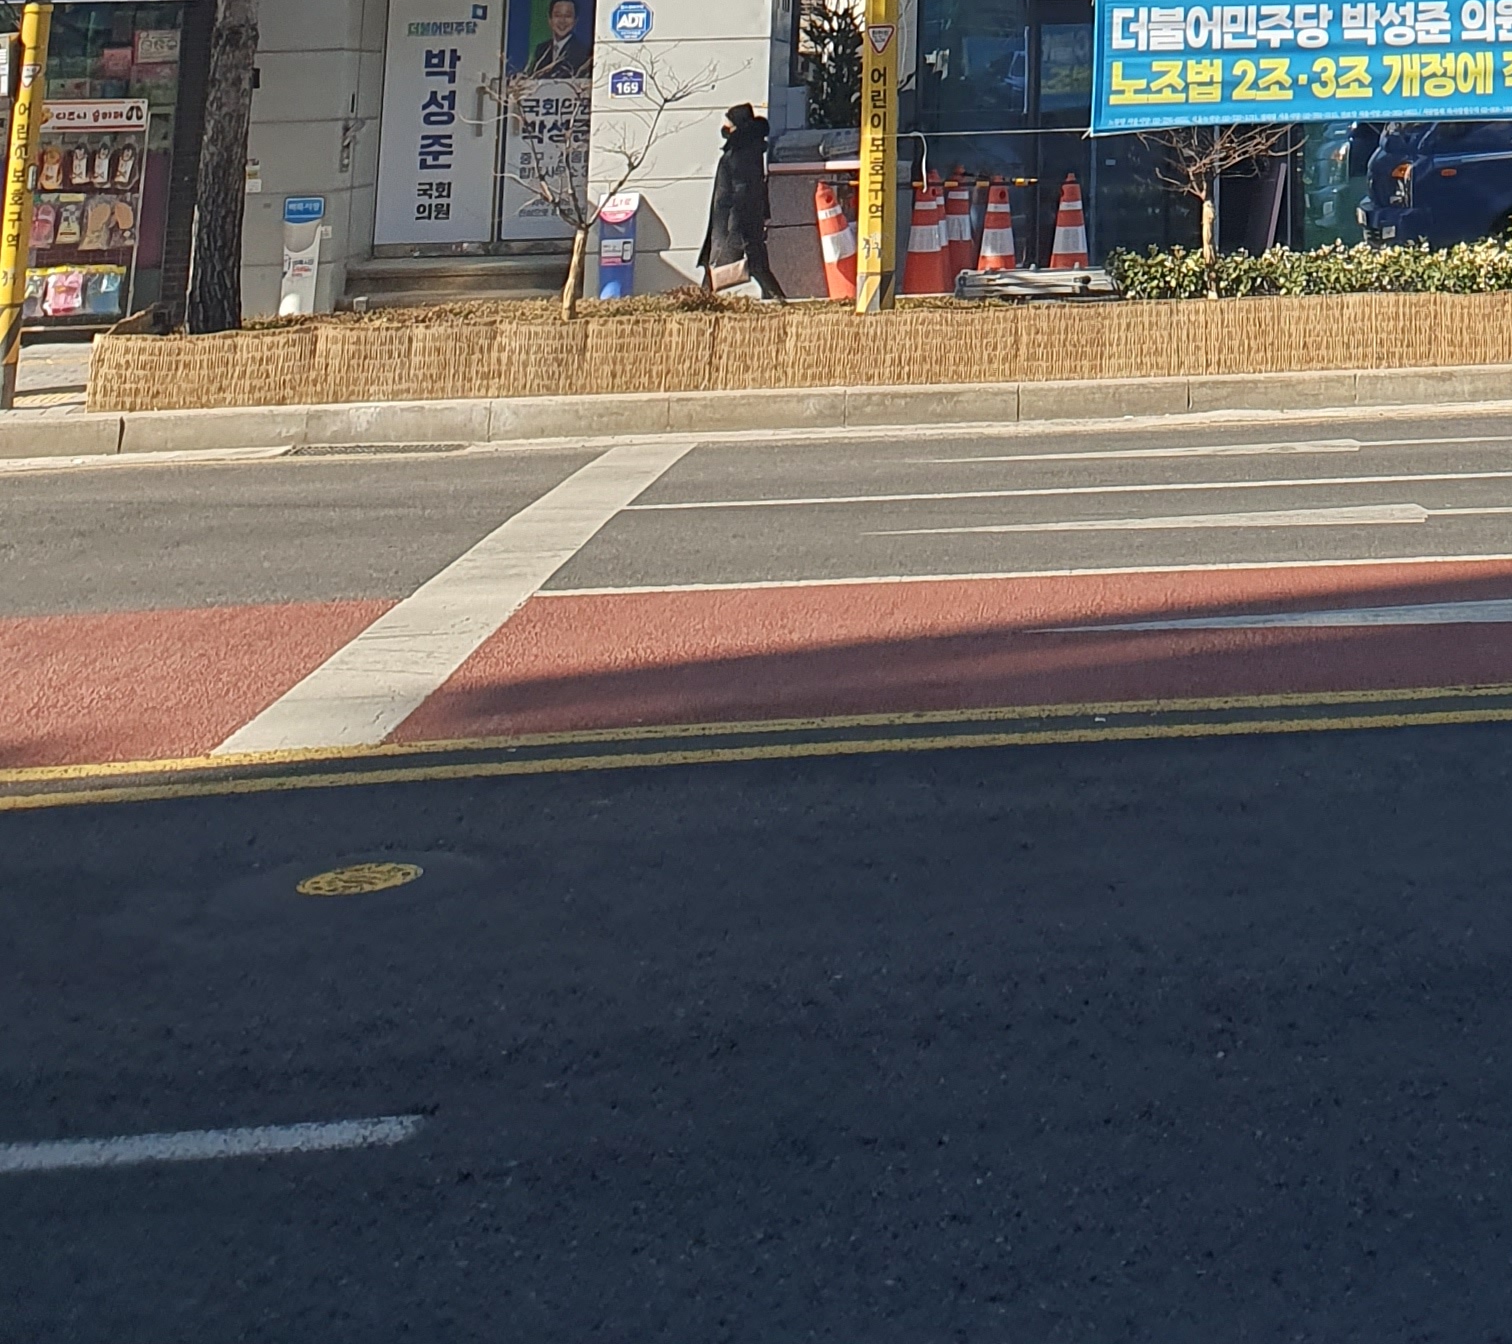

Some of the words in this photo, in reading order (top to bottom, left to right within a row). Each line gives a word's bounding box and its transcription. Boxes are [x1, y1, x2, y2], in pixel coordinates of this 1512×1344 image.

[408, 21, 478, 37] 더불어민주당
[617, 13, 647, 29] ADT
[1111, 1, 1330, 51] 더불어민주당
[1109, 57, 1223, 105] 노조법
[1382, 50, 1494, 97] 개정에
[616, 82, 639, 94] 169
[418, 49, 461, 170] 박성준
[868, 66, 888, 221] 어린이보호구역
[417, 182, 451, 199] 국회
[415, 203, 451, 221] 의원
